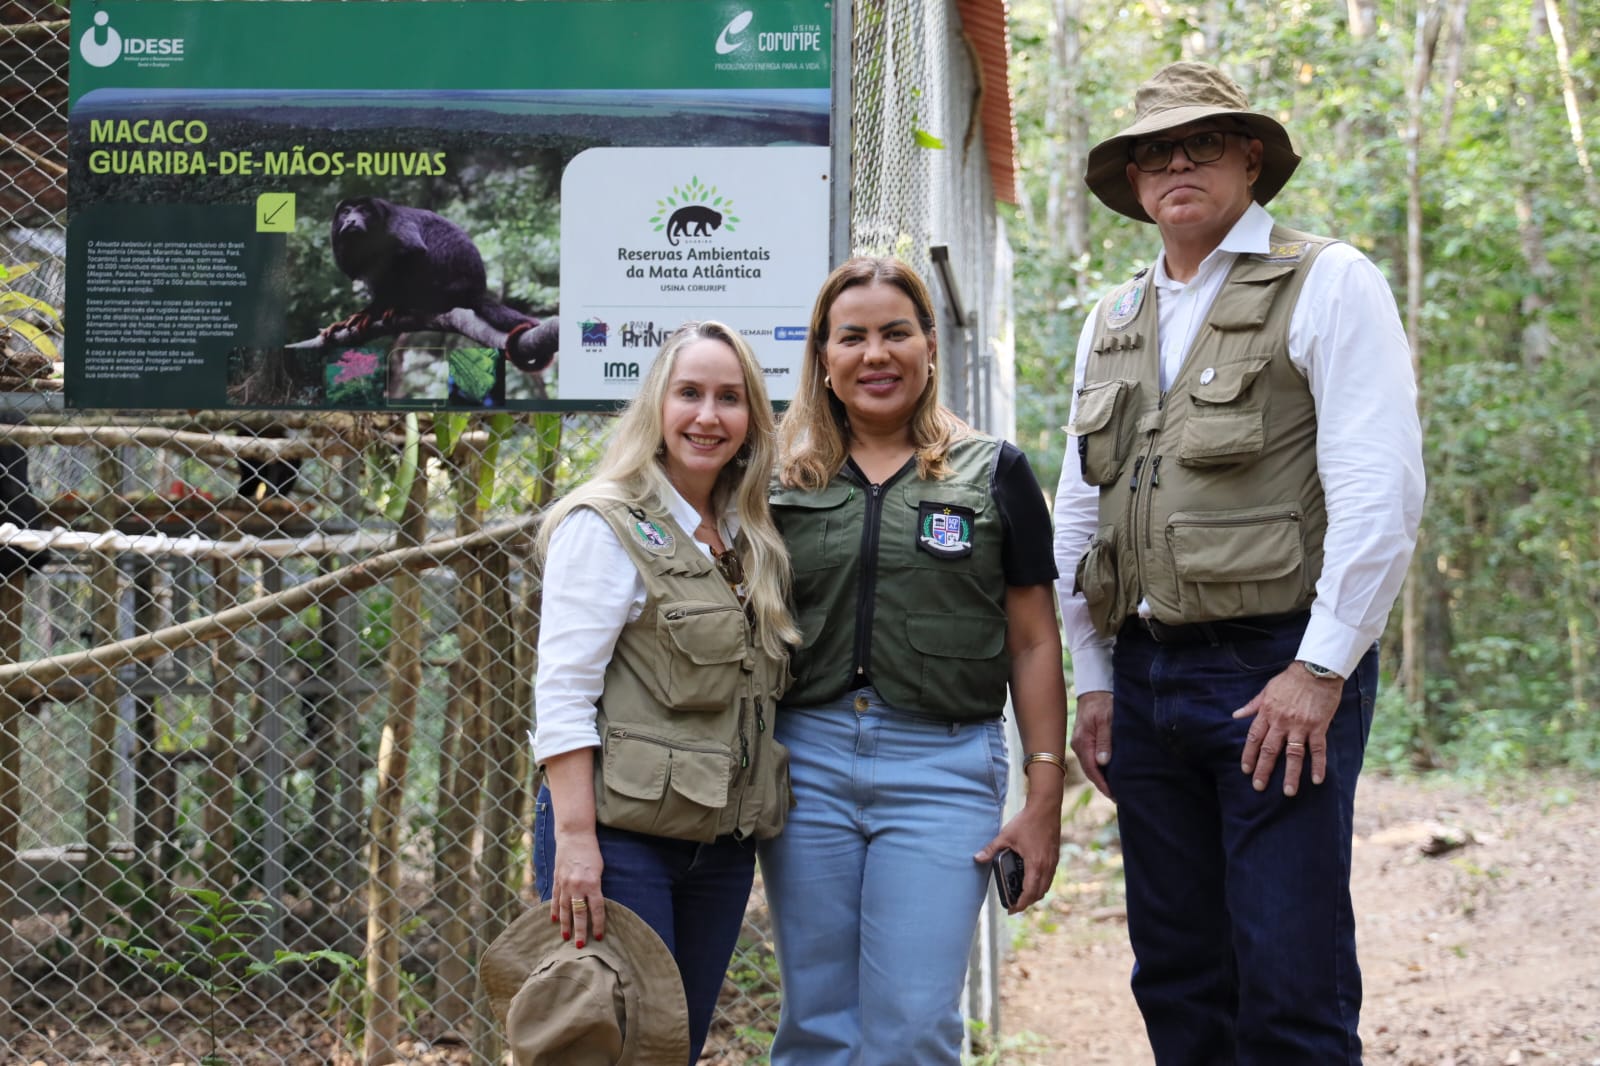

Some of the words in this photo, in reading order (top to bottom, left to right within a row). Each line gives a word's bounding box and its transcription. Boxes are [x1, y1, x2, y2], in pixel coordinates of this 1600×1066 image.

[124, 38, 184, 54] IDESE
[90, 120, 207, 144] MACACO
[89, 145, 446, 176] GUARIBA-DE-MÃOS-RUIVAS
[618, 248, 682, 261] Reservas
[688, 247, 770, 261] Ambientais
[626, 266, 644, 279] da
[649, 266, 688, 279] Mata
[693, 264, 761, 279] Atlântica
[604, 362, 639, 377] IMA
